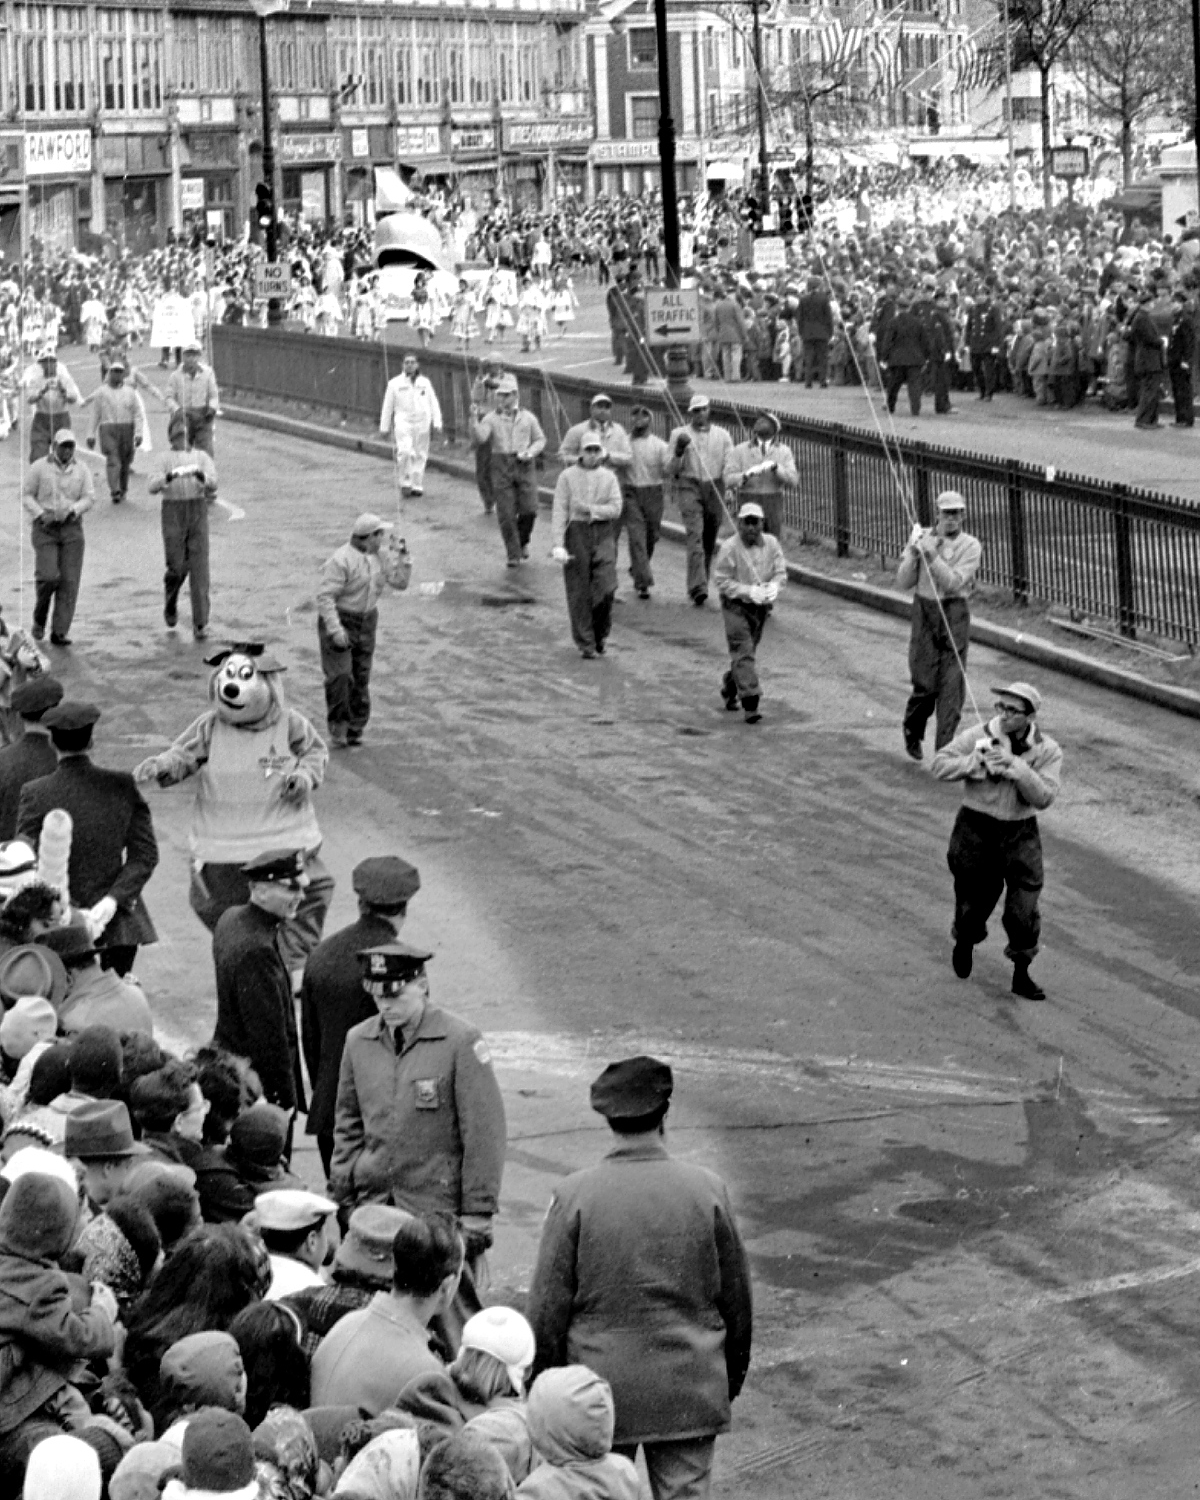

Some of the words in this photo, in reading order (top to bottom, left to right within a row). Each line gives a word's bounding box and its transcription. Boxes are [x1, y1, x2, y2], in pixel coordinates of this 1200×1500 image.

[264, 267, 282, 278] NO
[258, 280, 288, 292] TURNS
[662, 295, 683, 306] ALL
[651, 308, 697, 322] TRAFFIC
